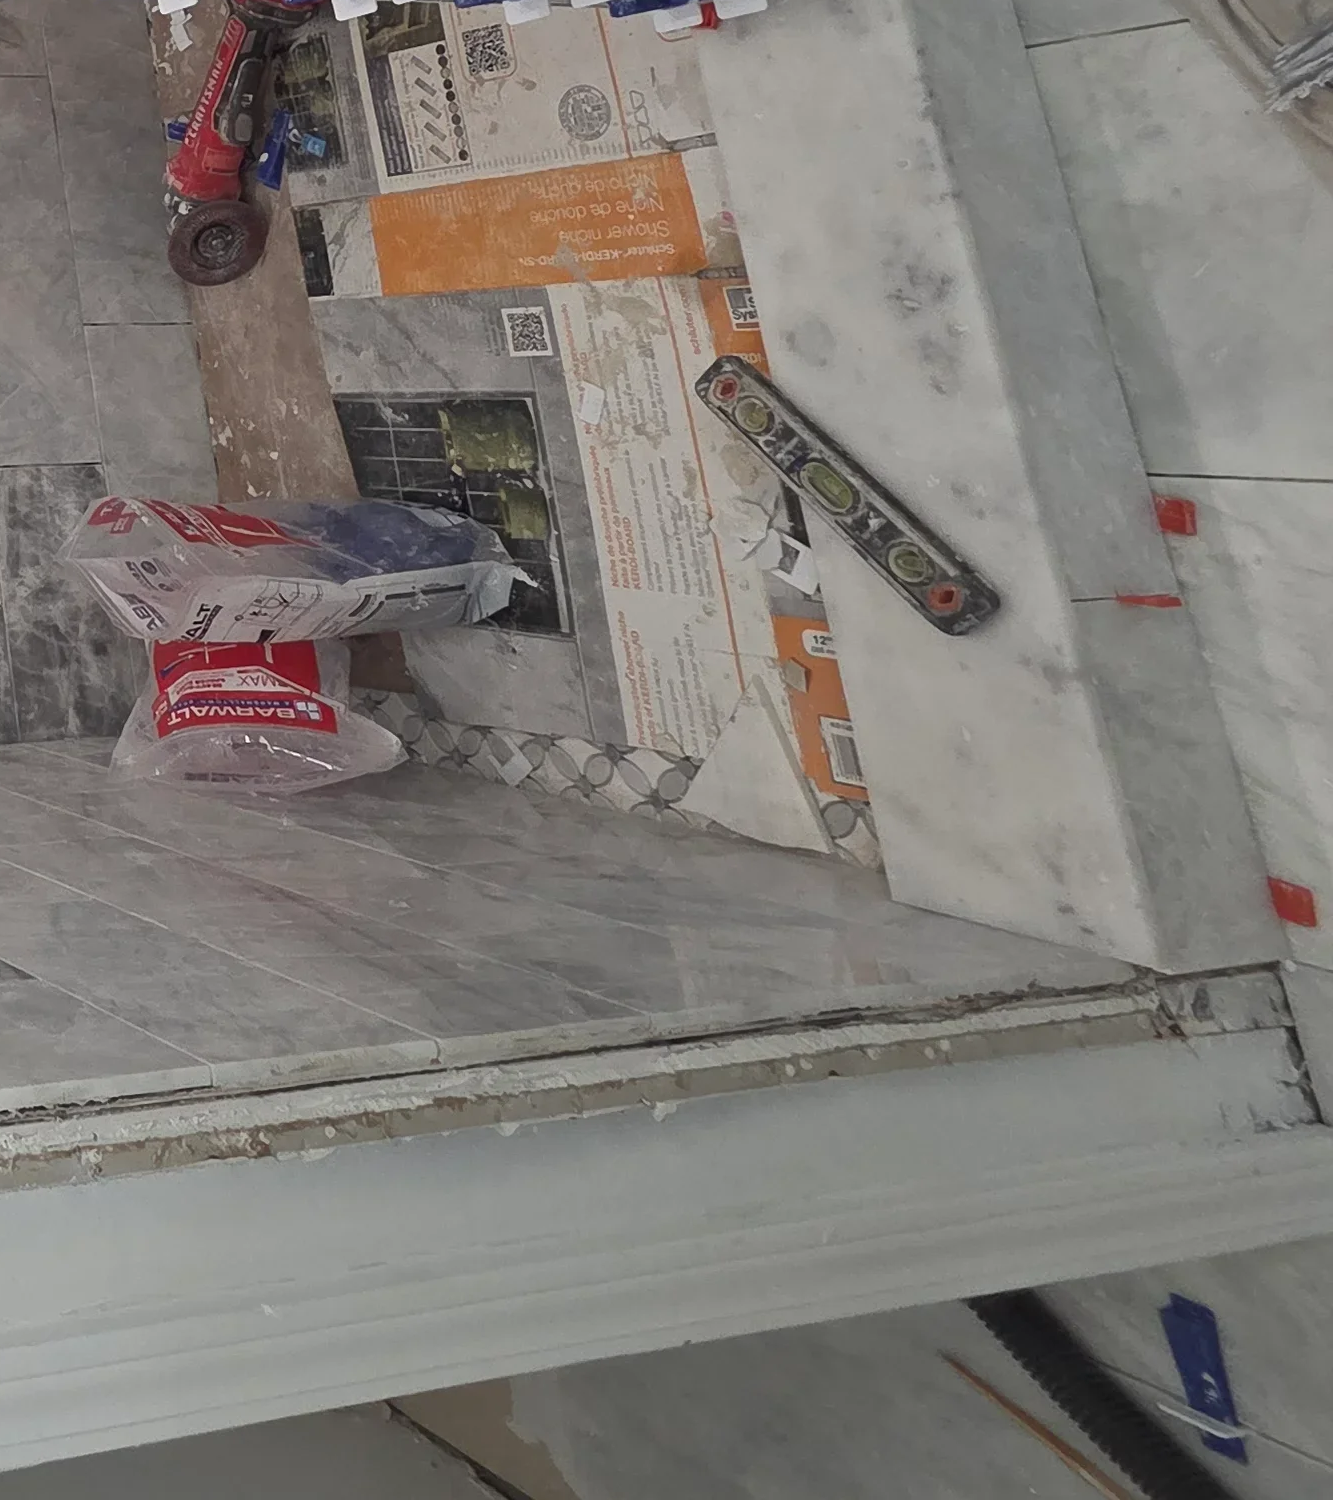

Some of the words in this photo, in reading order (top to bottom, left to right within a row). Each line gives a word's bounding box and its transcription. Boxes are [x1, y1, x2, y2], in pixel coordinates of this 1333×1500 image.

[189, 58, 224, 139] CRAFTSMAN
[530, 205, 587, 226] douche
[589, 201, 611, 218] de
[615, 194, 665, 216] Niche
[559, 228, 602, 244] niche
[608, 220, 671, 239] Shower
[168, 705, 297, 726] BARWALT
